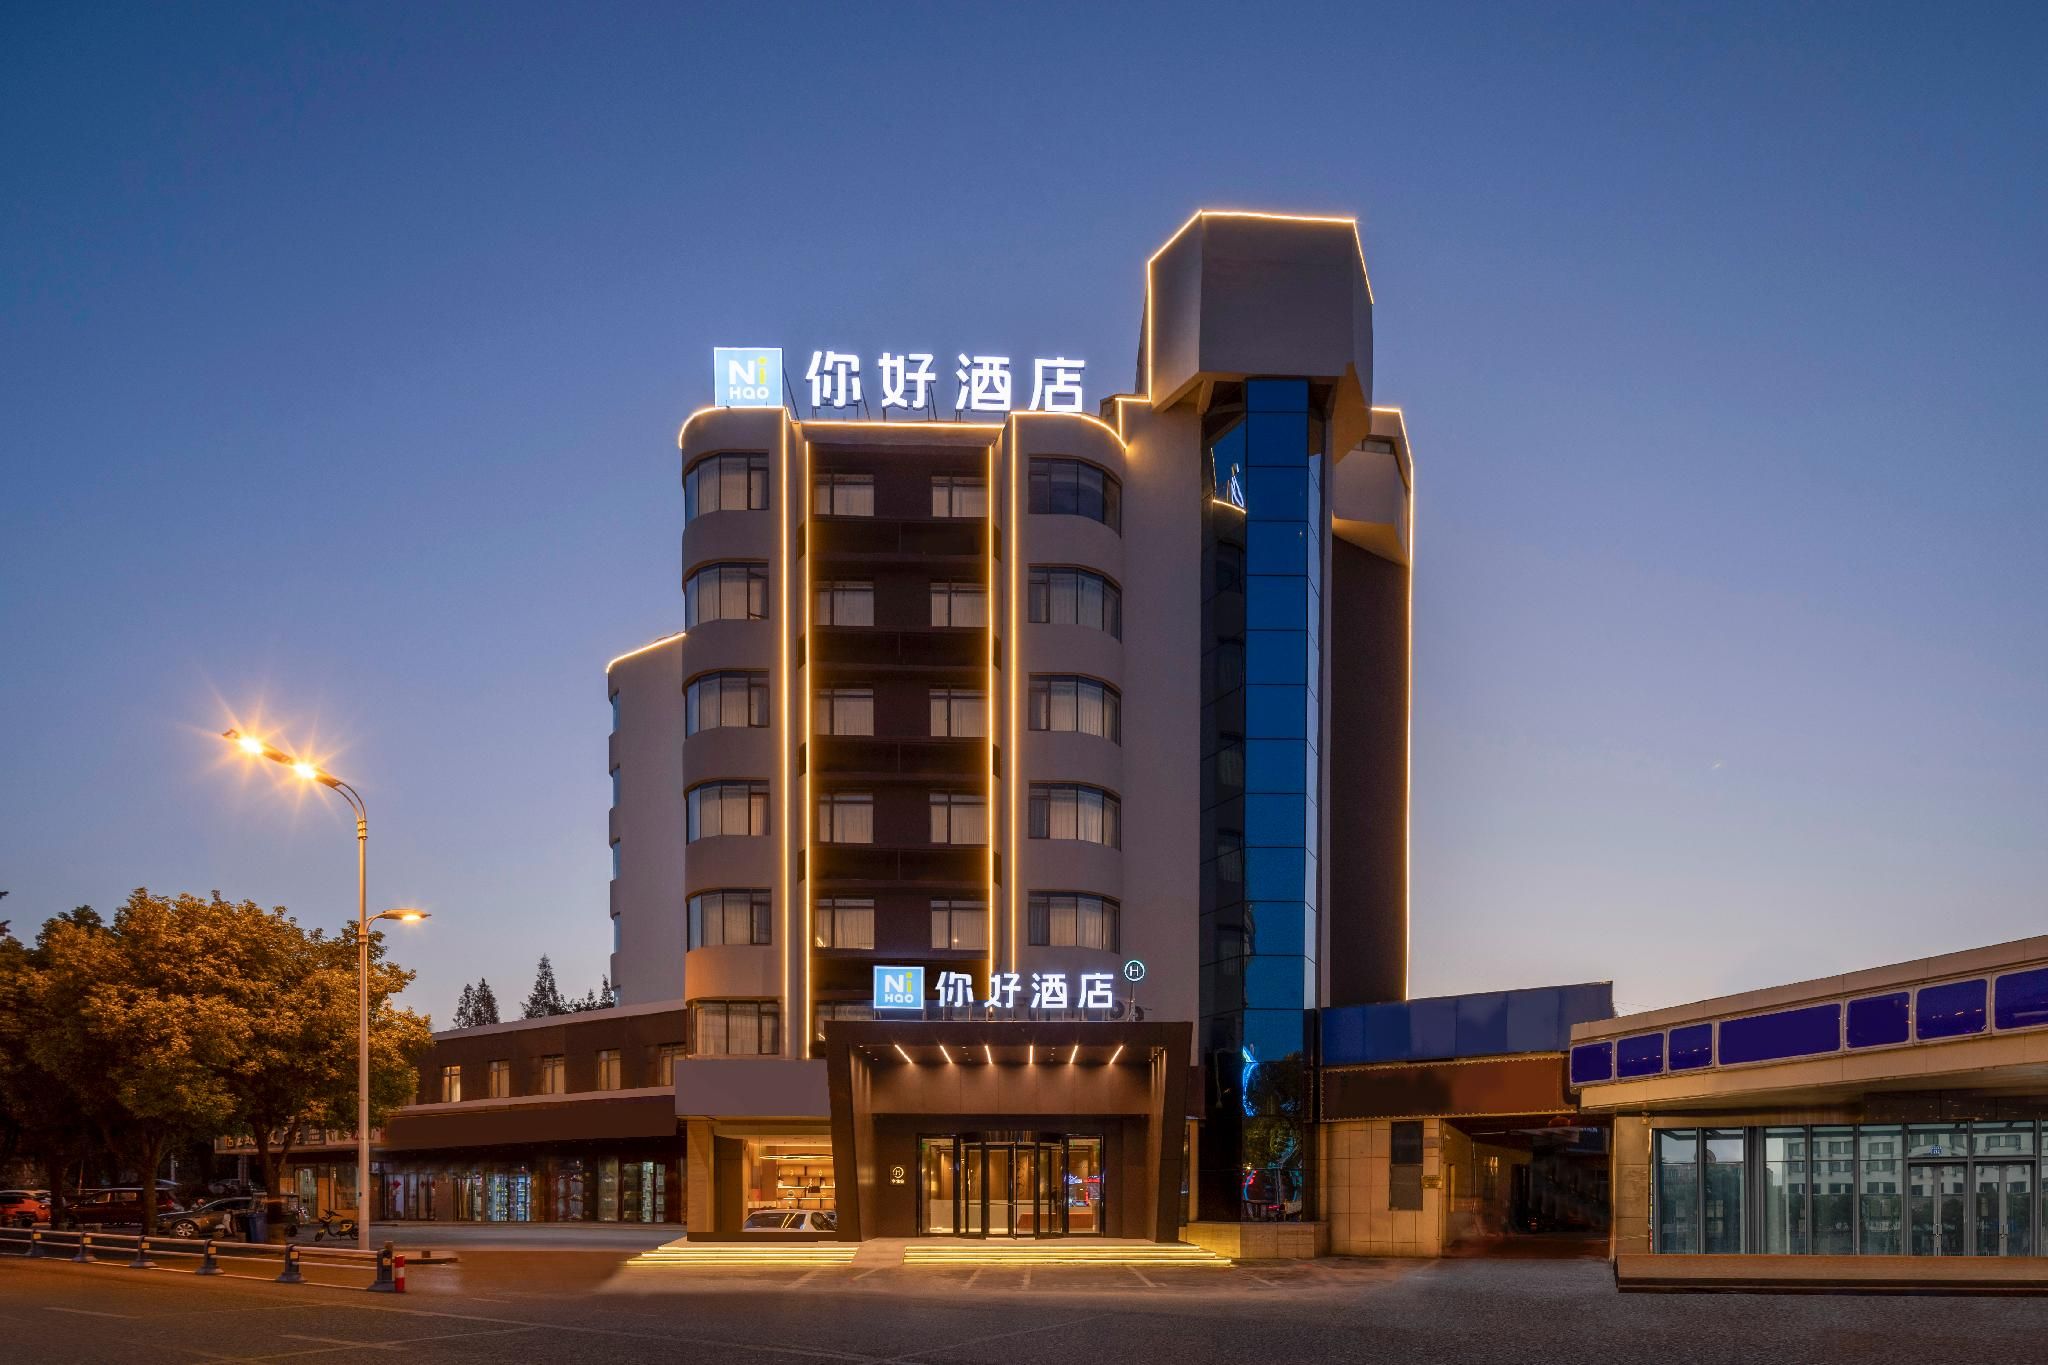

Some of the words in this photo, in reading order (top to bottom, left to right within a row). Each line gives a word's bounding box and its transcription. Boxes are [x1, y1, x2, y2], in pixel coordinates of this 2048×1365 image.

[728, 355, 768, 385] Ni
[805, 350, 1086, 413] 你好酒店
[884, 971, 913, 993] Ni
[934, 971, 1114, 1009] 你好酒店
